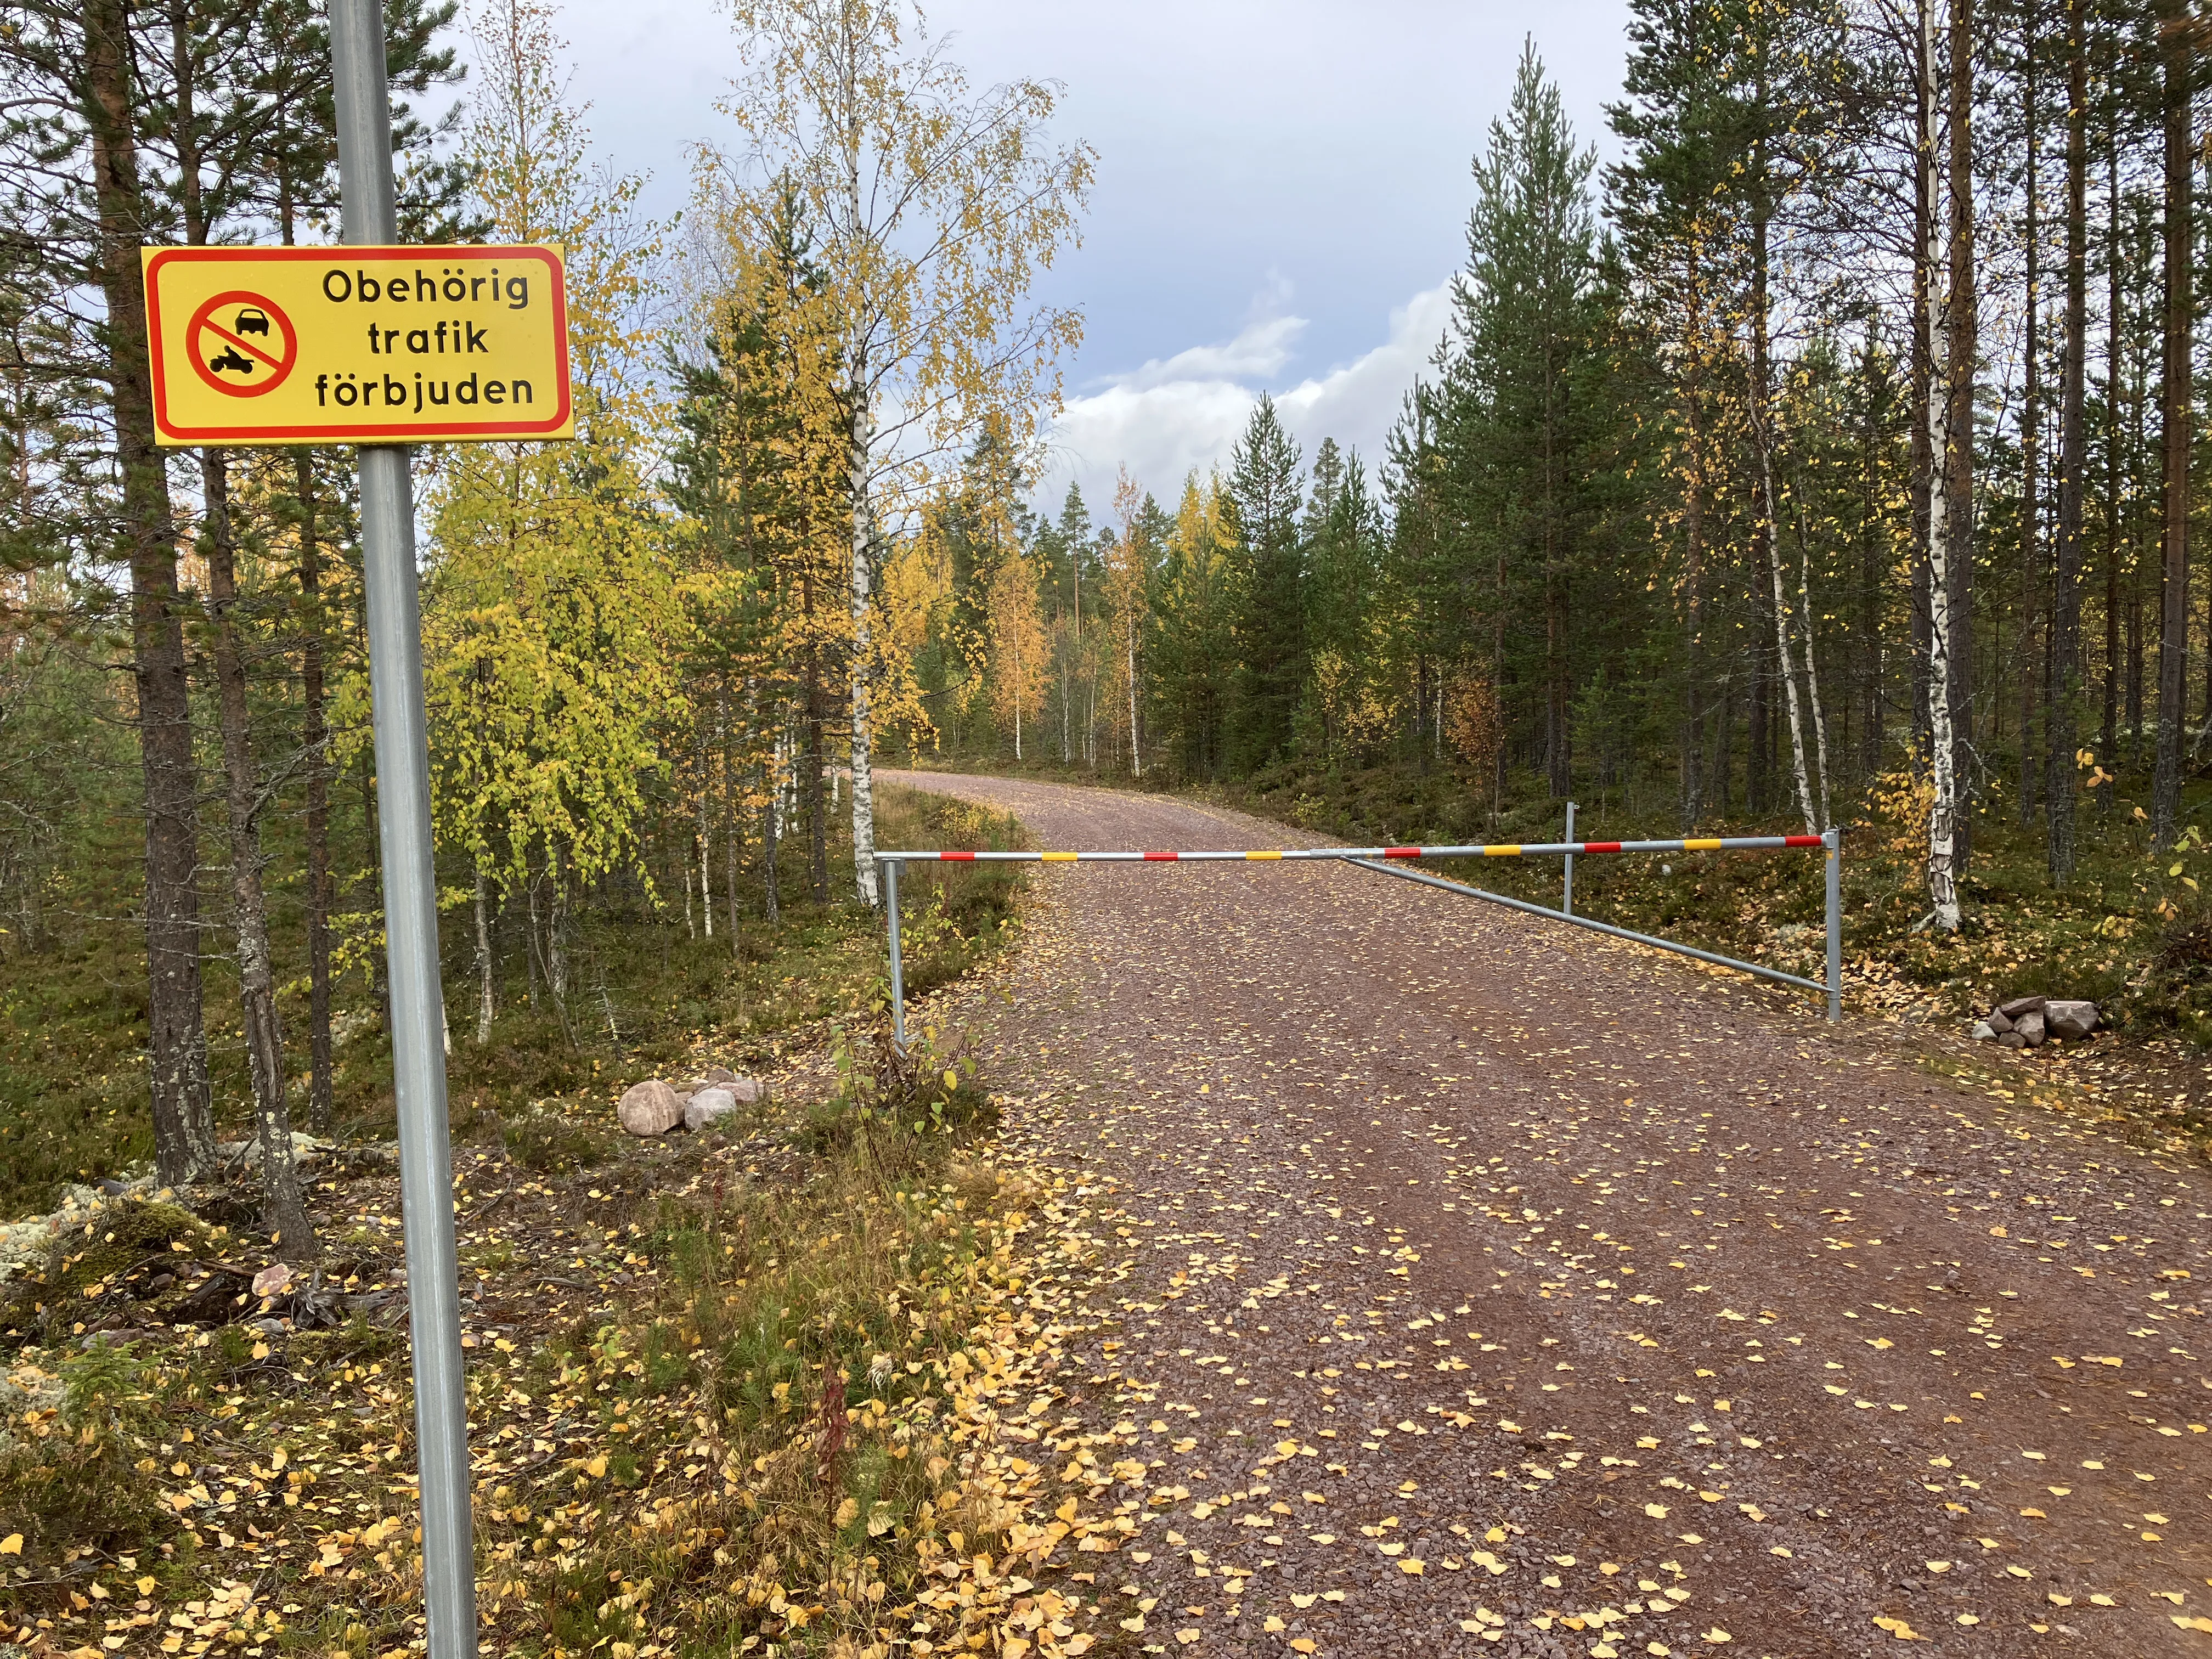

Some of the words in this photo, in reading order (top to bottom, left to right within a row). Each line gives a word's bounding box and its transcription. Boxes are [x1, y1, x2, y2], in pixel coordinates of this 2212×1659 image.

[323, 268, 528, 309] Obehörig
[368, 320, 489, 354] trafik
[315, 373, 533, 414] förbjuden
